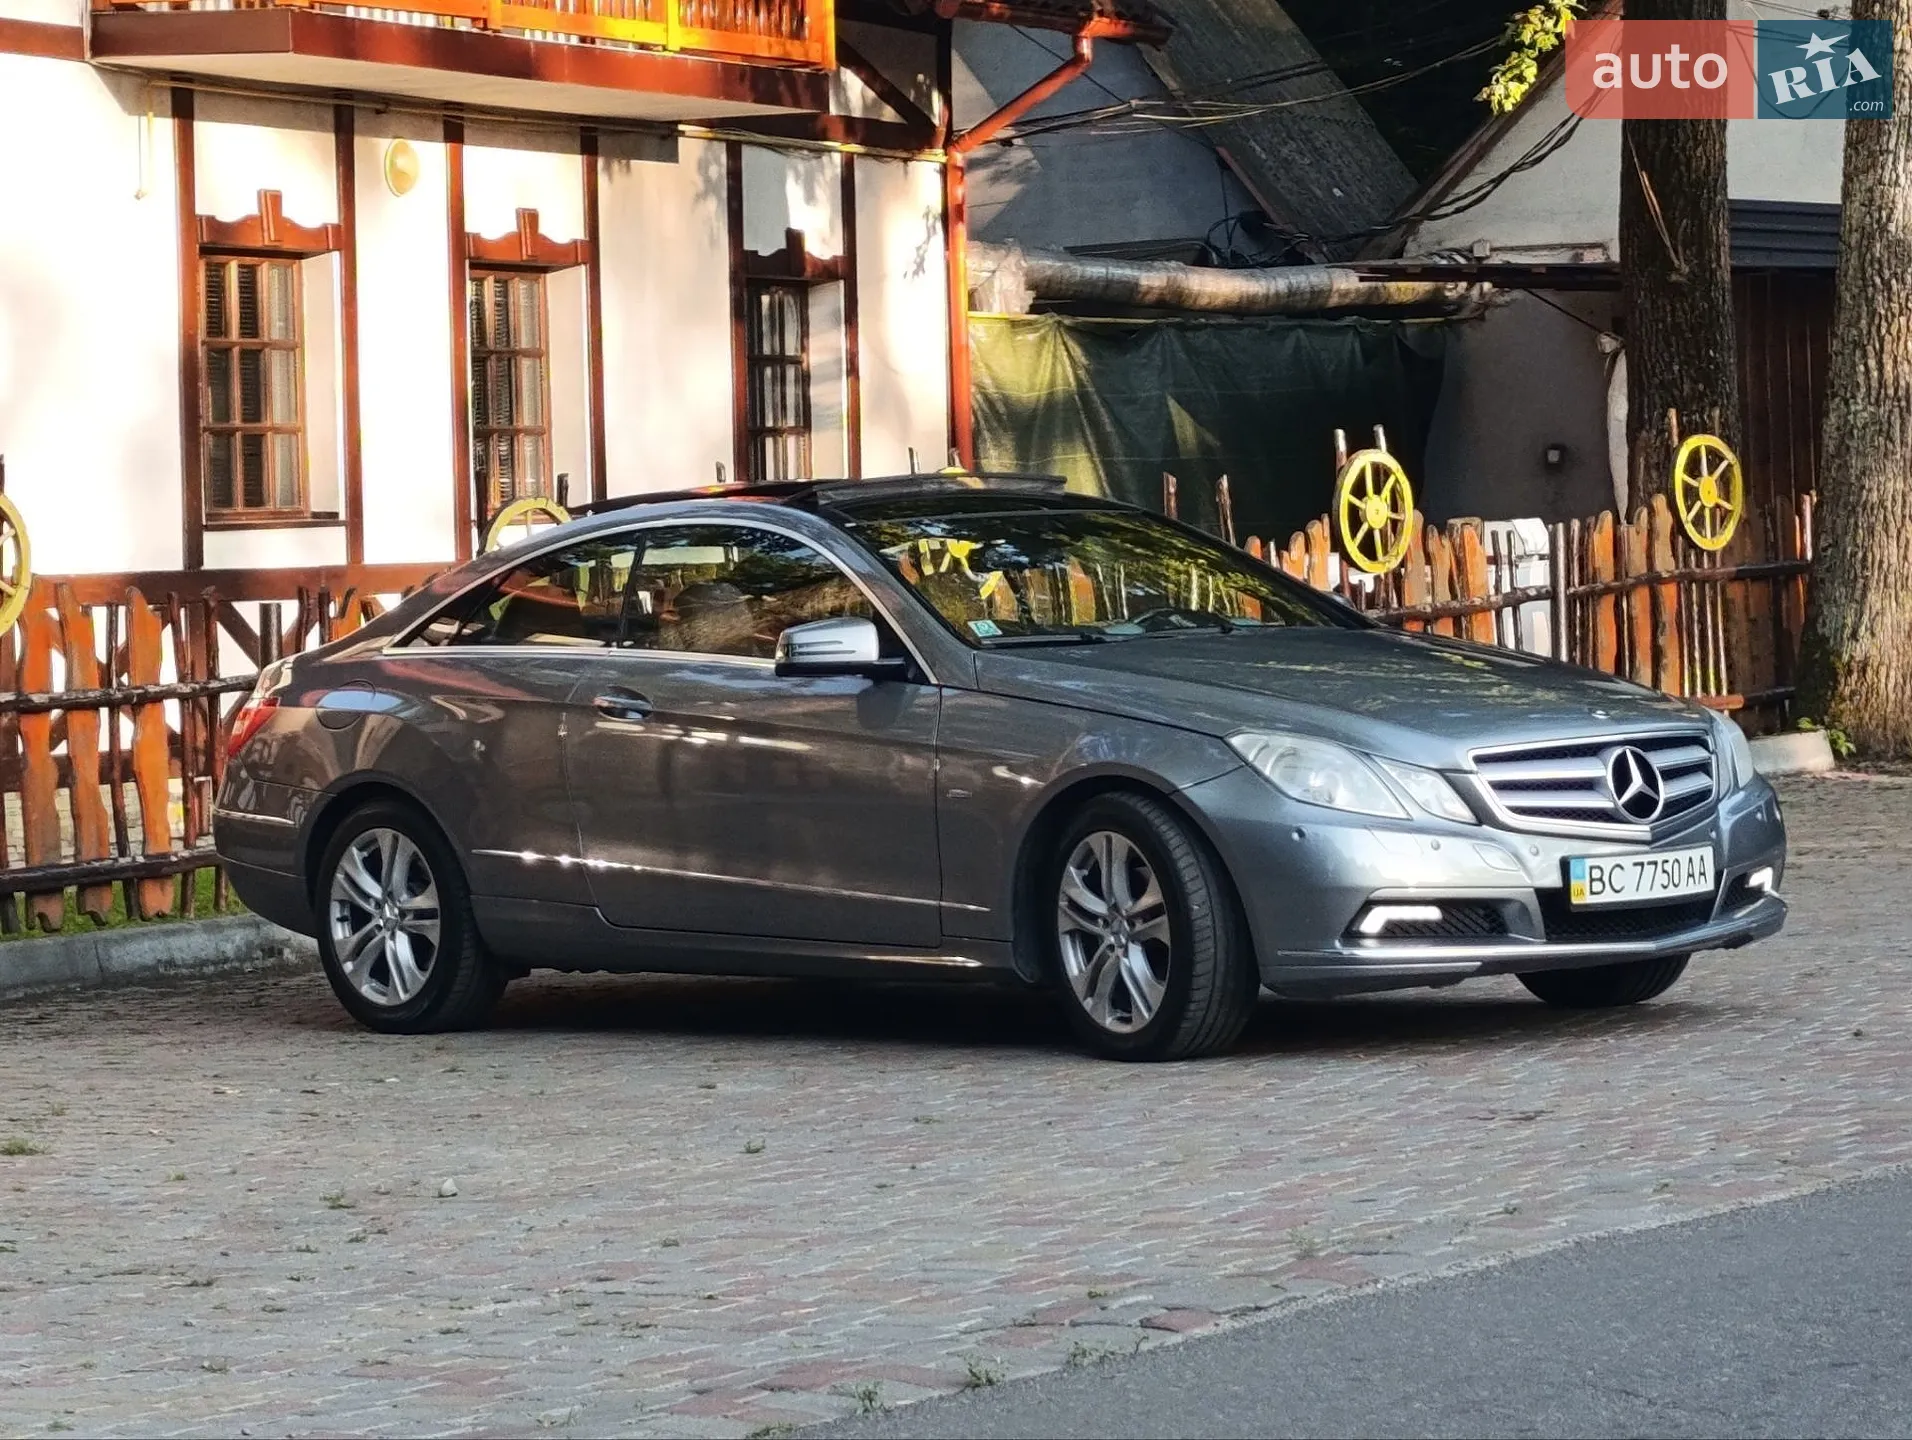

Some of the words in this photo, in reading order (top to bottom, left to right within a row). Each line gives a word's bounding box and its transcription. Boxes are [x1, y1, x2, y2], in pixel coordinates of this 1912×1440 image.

[1589, 863, 1625, 896] BC
[1632, 858, 1681, 893] 7750
[1686, 854, 1708, 887] AA
